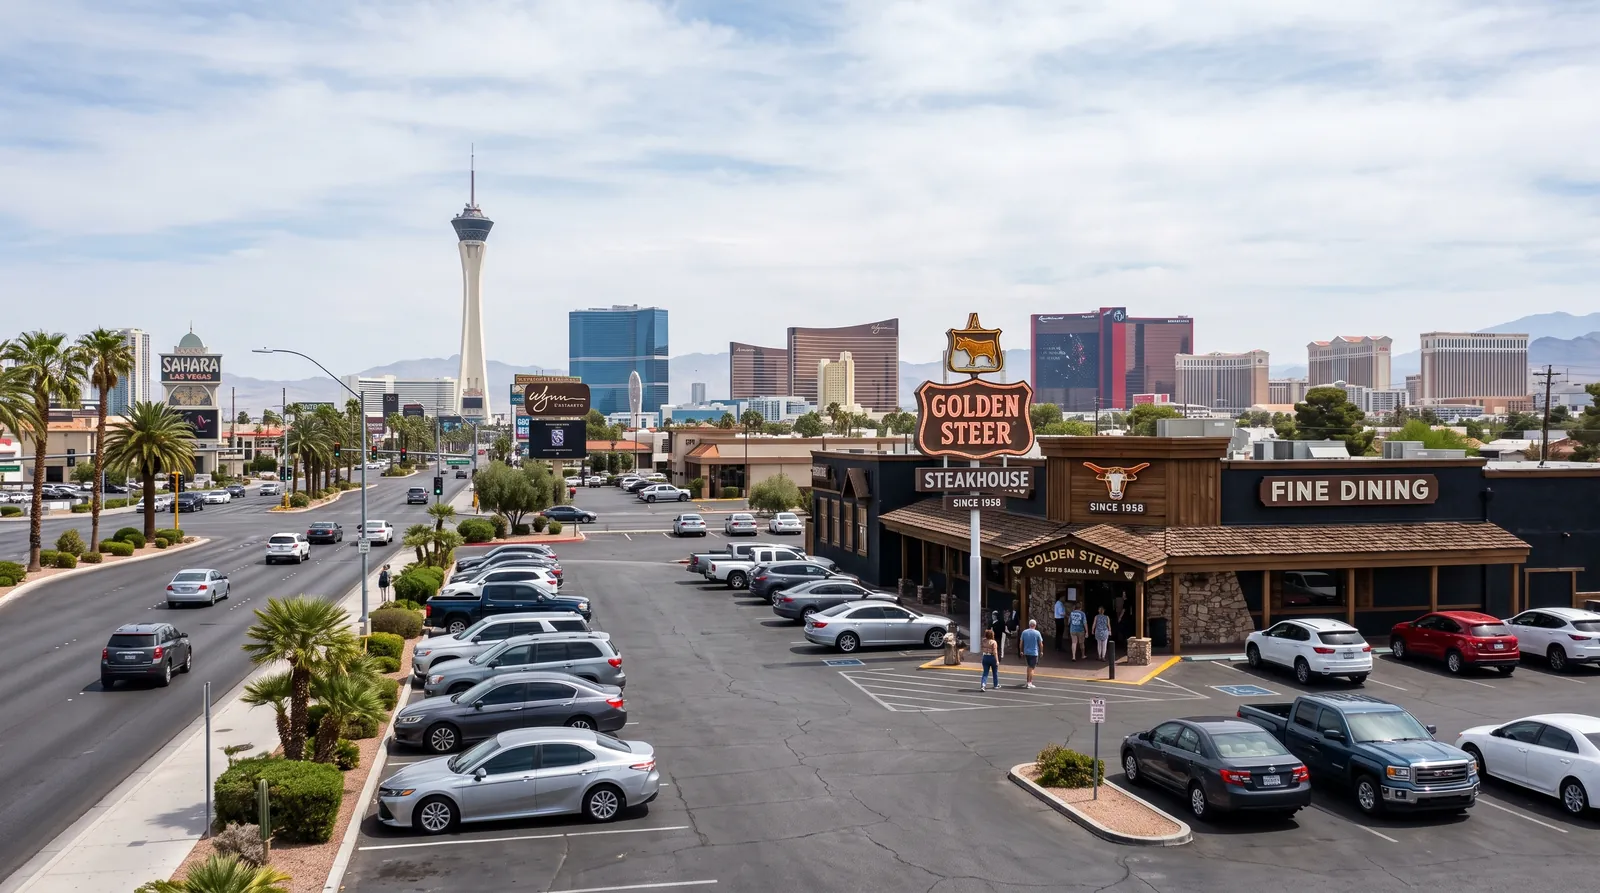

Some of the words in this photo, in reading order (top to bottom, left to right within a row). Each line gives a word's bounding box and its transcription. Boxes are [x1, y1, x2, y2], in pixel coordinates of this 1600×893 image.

[162, 357, 219, 372] SAHARA
[931, 394, 1020, 418] GOLDEN
[941, 421, 1012, 445] STEER
[924, 470, 1029, 489] STEAKHOUSE
[1271, 480, 1330, 502] FINE
[1340, 479, 1429, 501] DINING
[953, 498, 979, 507] SINCE
[981, 498, 1001, 507] 1958
[1090, 502, 1118, 512] SINCE
[1121, 503, 1144, 513] 1958
[1025, 548, 1075, 569] GOLDEN
[1079, 549, 1120, 574] STEER
